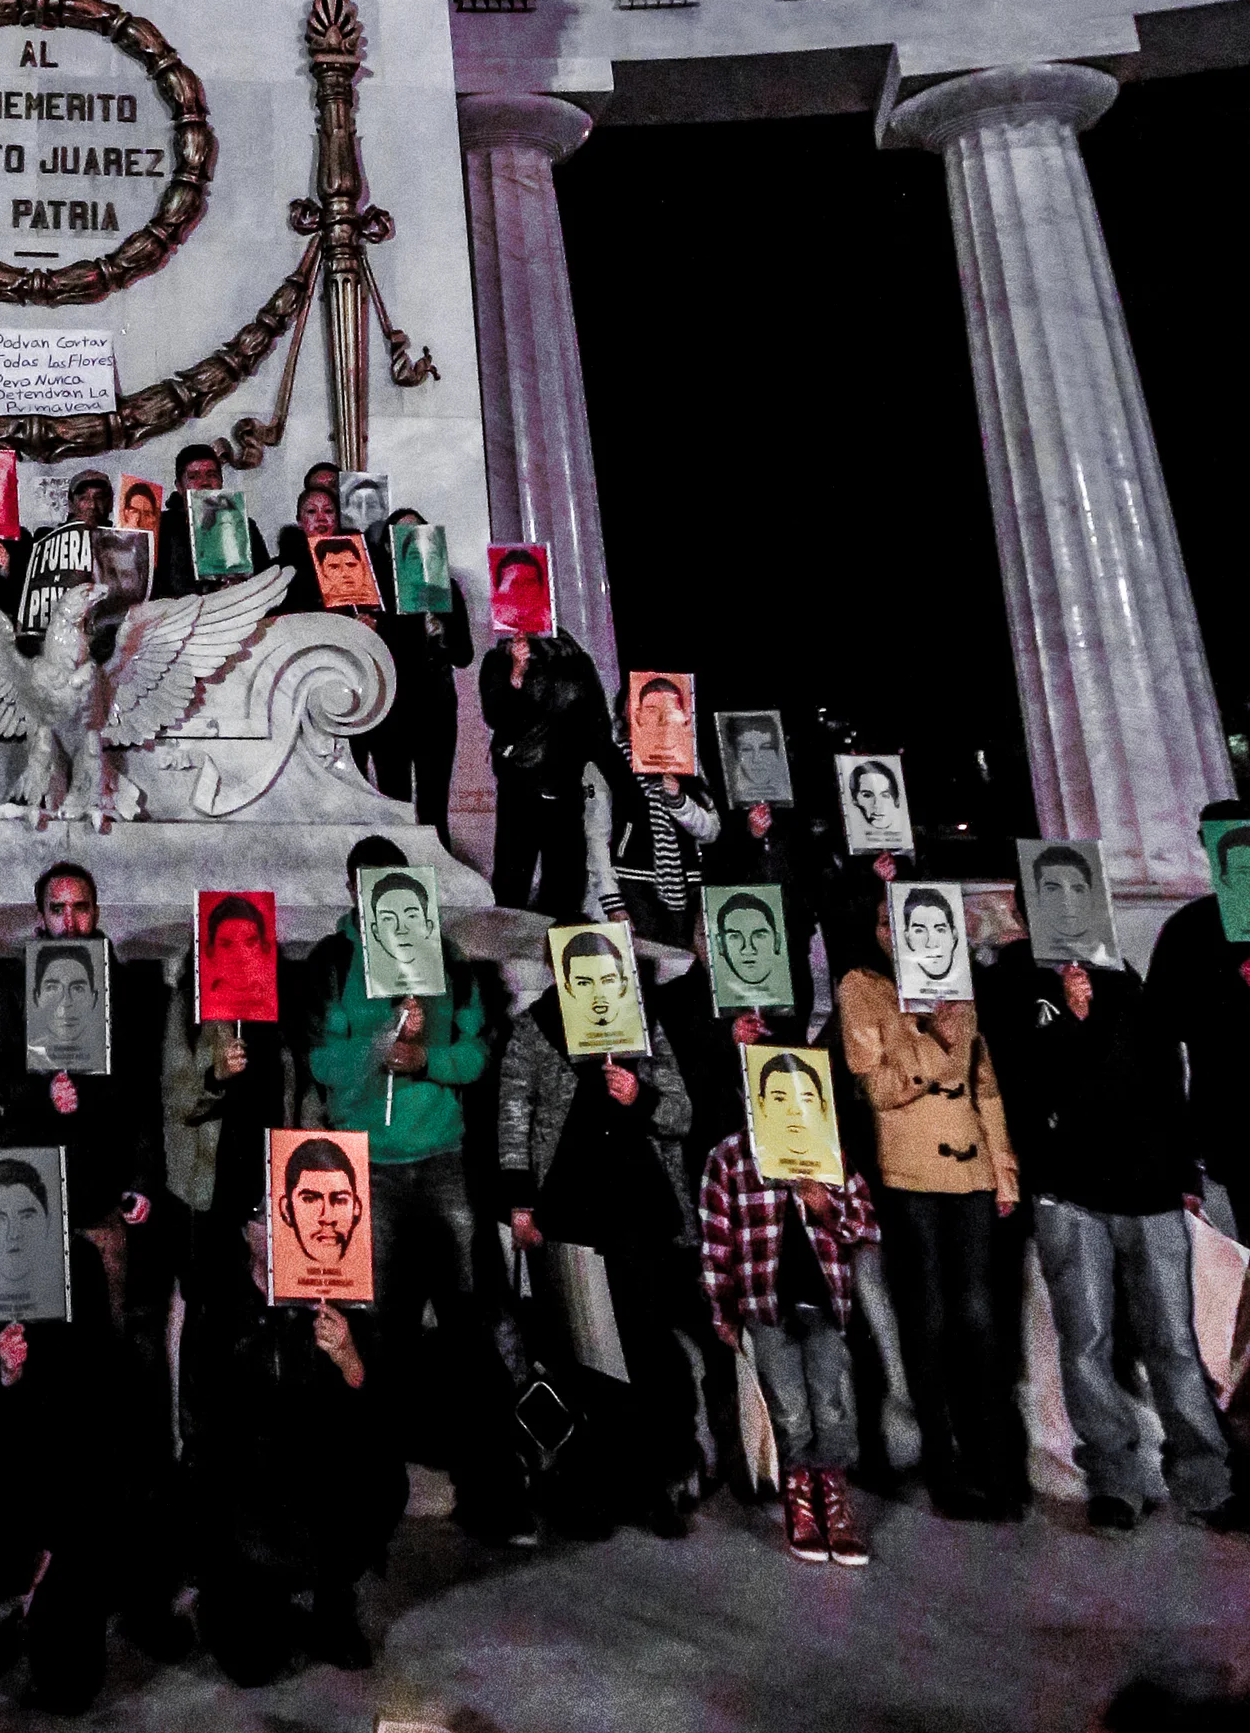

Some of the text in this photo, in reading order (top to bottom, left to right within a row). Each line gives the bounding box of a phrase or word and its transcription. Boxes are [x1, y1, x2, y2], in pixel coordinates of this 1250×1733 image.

[20, 40, 58, 68] AL
[39, 146, 165, 177] JUAREZ
[12, 199, 120, 231] PATRIA
[34, 374, 84, 386] Nunca
[90, 387, 109, 399] La
